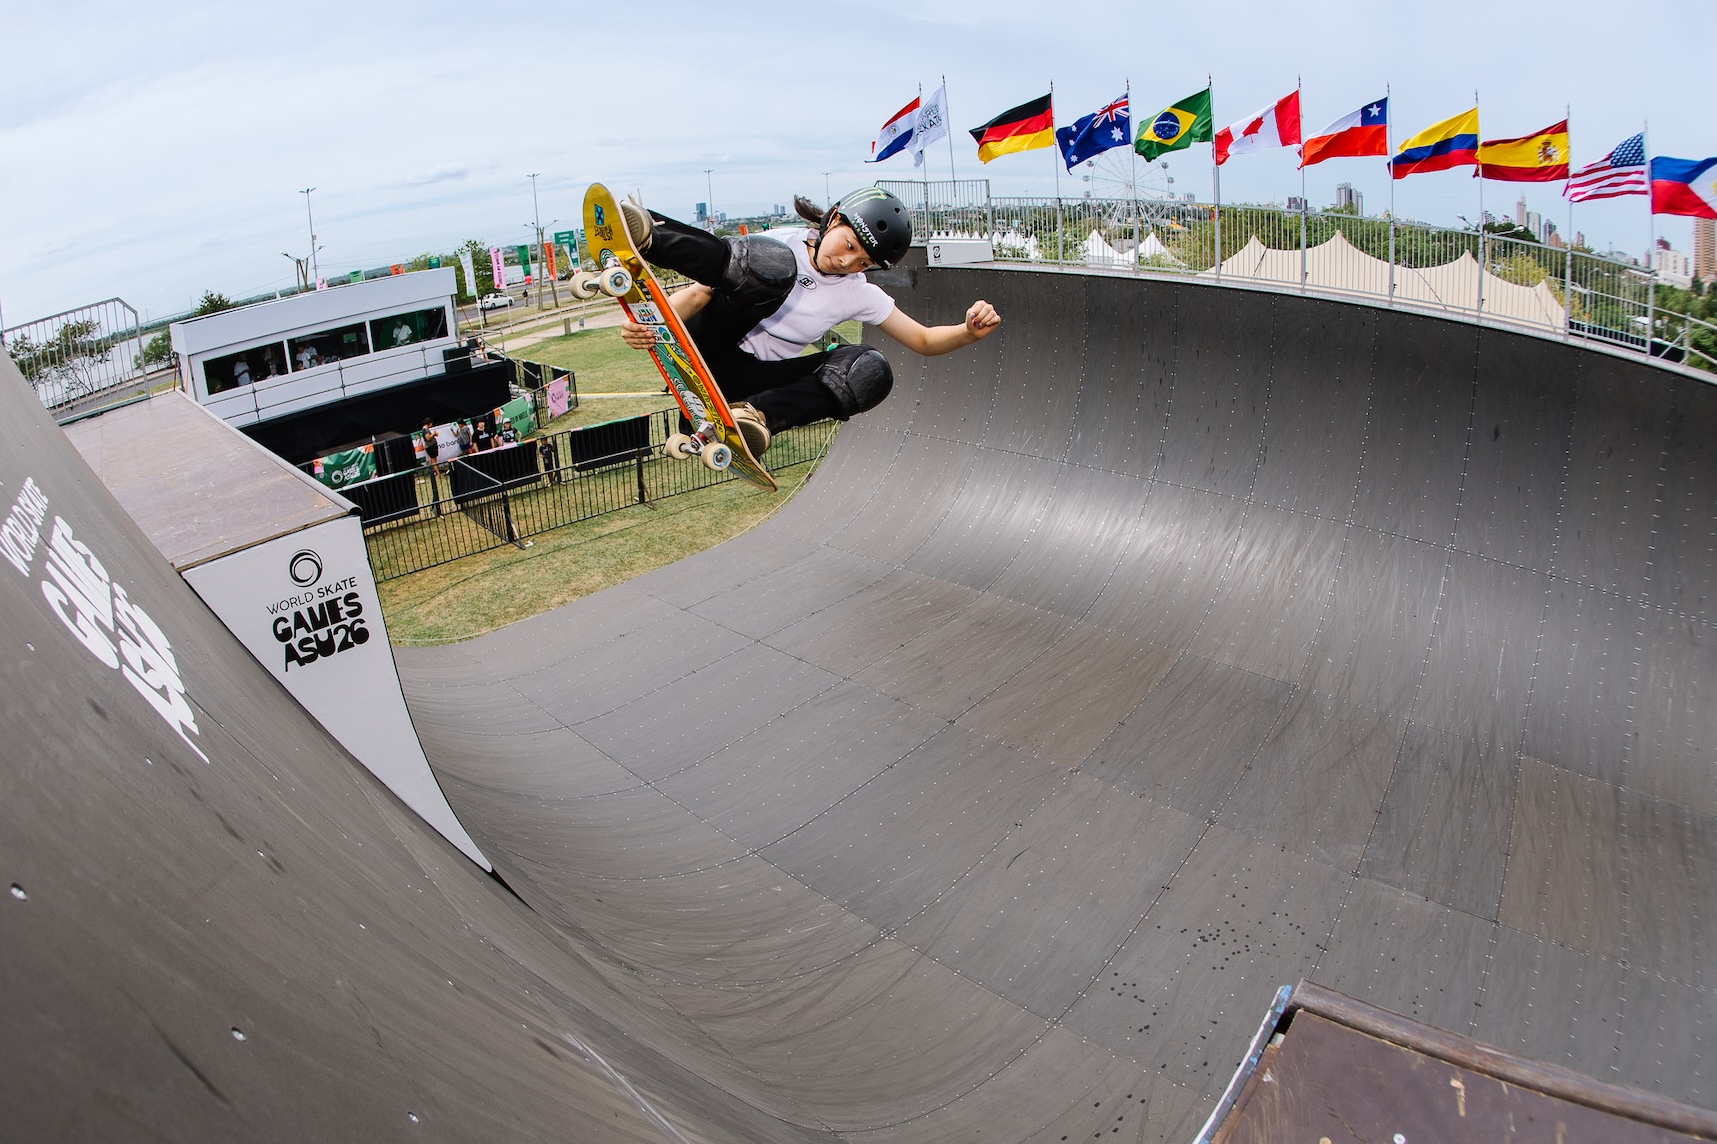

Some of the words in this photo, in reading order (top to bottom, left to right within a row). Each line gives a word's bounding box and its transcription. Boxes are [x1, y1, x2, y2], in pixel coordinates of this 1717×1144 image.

[853, 212, 879, 248] MONSTER
[446, 438, 460, 448] ban
[18, 477, 48, 526] SKATE
[0, 505, 39, 578] WORLD
[266, 592, 314, 615] WORLD
[317, 577, 357, 598] SKATE
[273, 592, 363, 643] GAMES
[285, 618, 370, 672] ASU26
